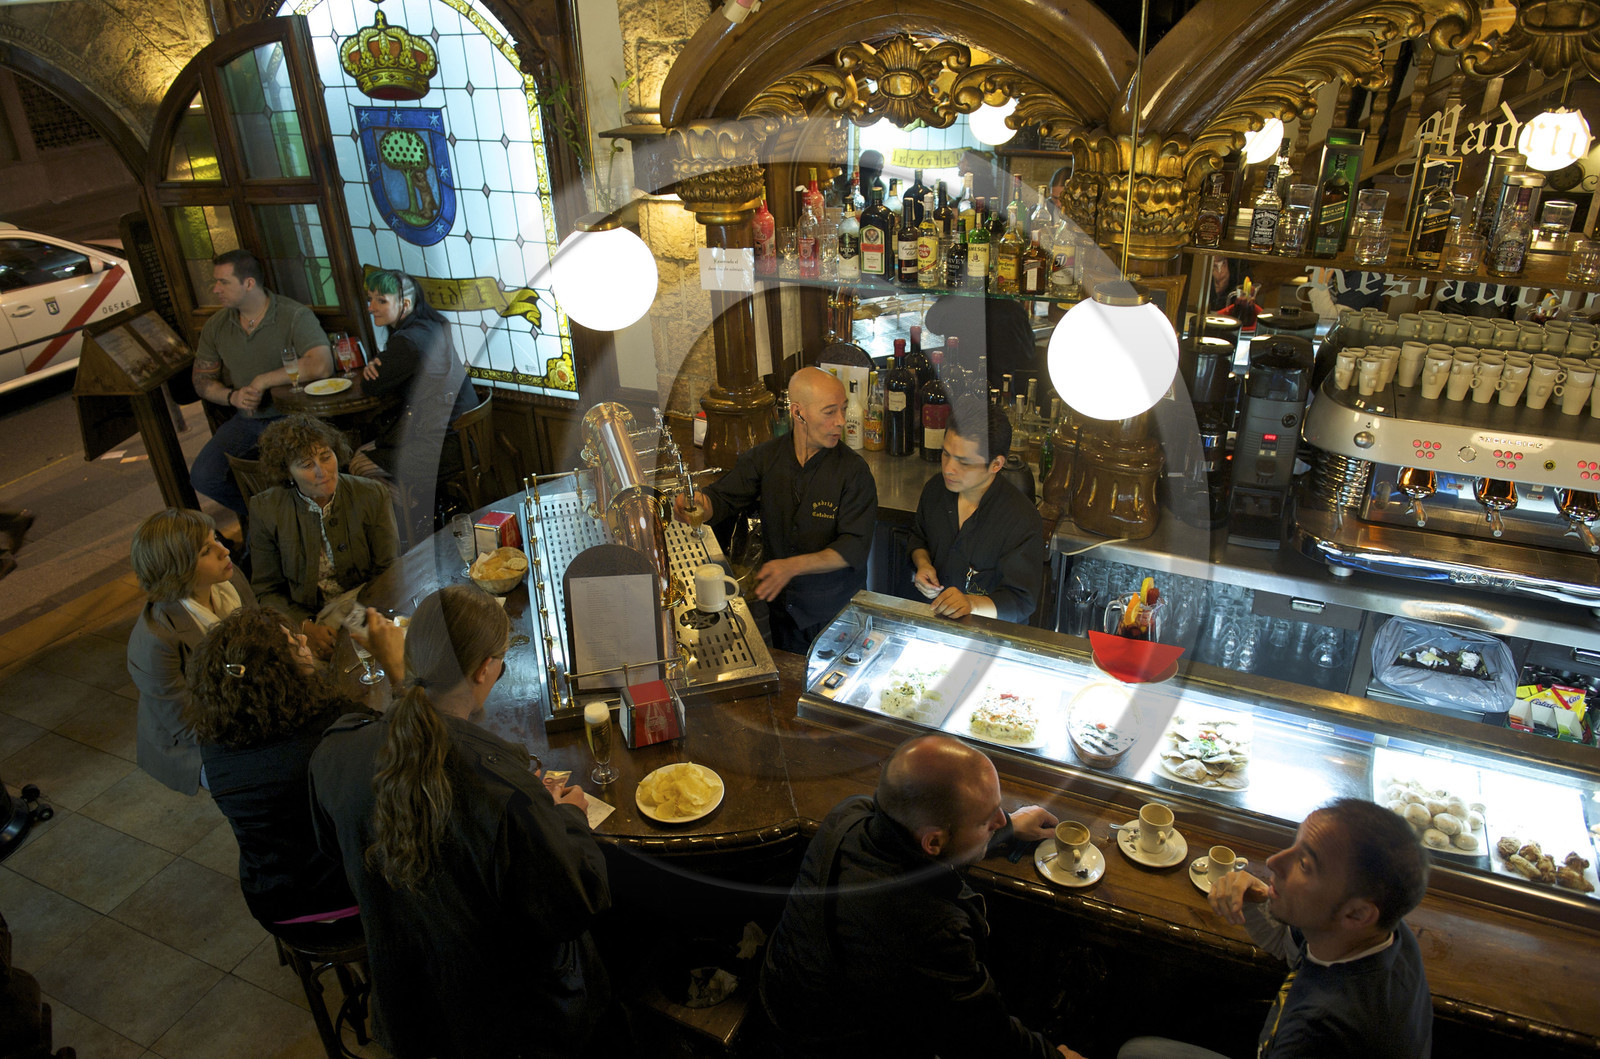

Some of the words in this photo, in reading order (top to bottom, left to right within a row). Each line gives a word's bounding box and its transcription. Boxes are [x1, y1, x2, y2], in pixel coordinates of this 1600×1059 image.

[1404, 100, 1596, 170] Madrid
[1055, 255, 1066, 267] 51
[1449, 569, 1517, 588] BRASILIA
